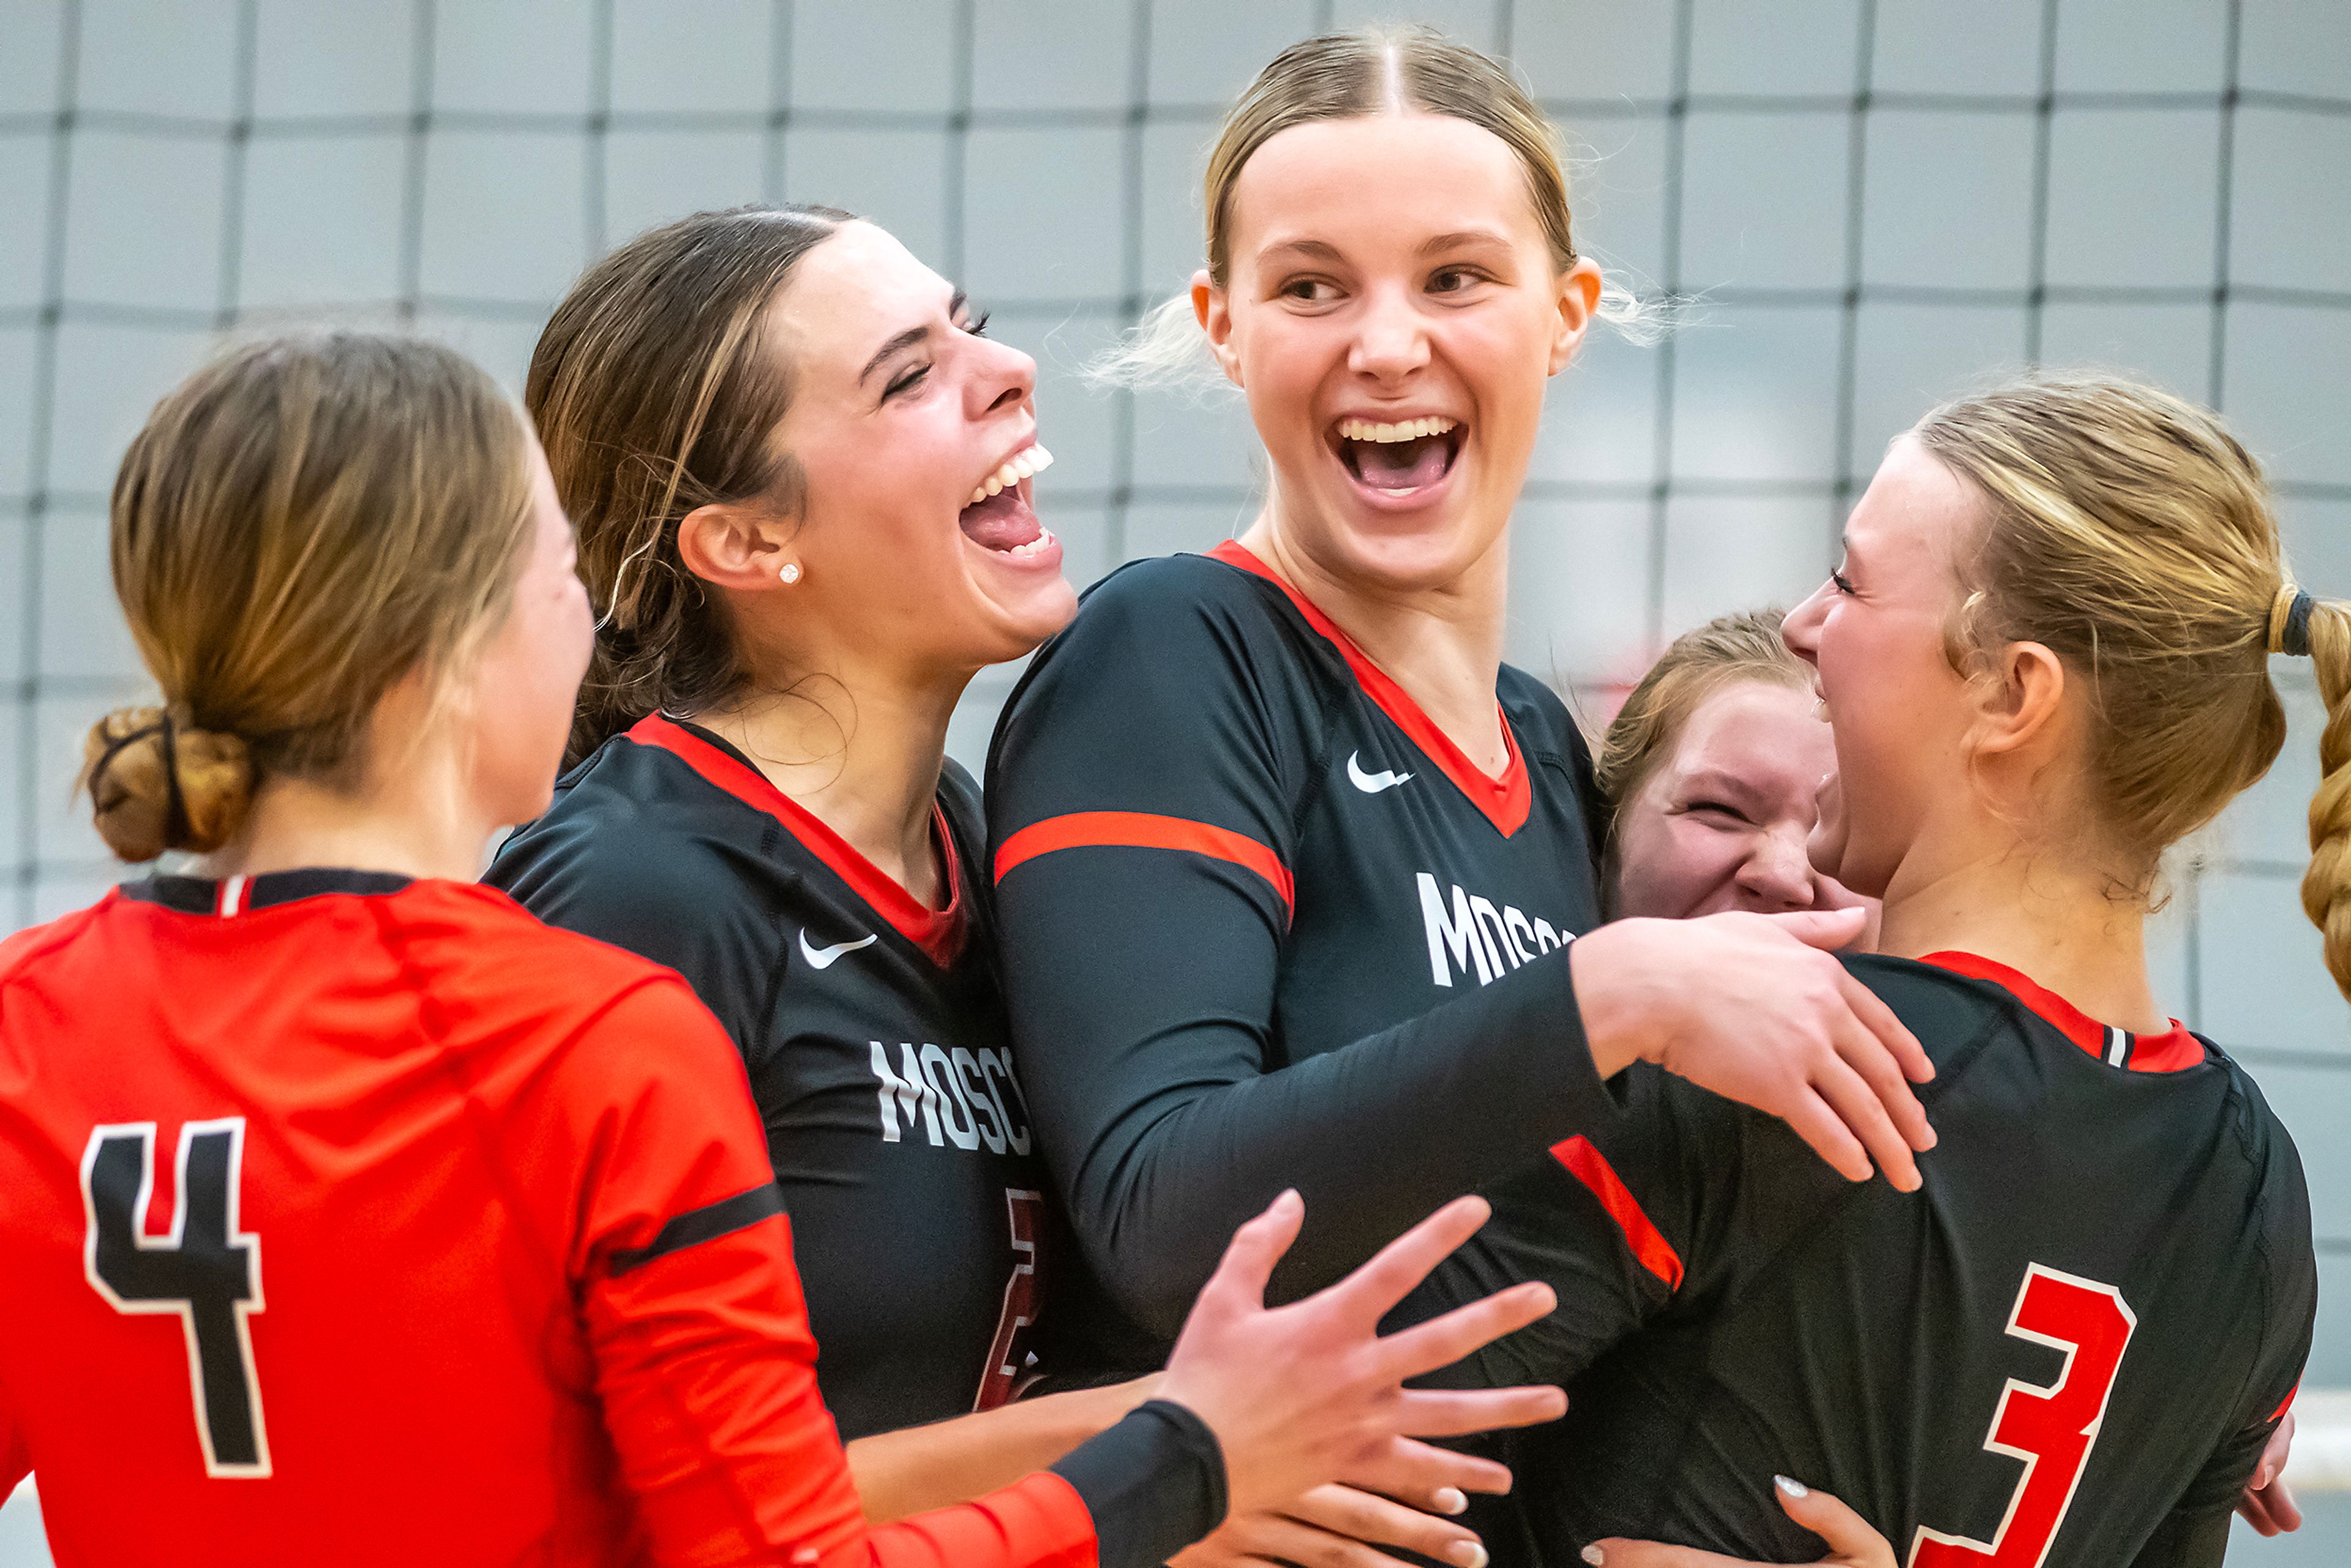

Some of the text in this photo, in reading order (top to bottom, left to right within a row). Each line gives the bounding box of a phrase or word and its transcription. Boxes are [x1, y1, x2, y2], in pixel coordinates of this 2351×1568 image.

[870, 1041, 1032, 1156] MOSC
[80, 1117, 273, 1479] 4
[1907, 1261, 2137, 1568] 3
